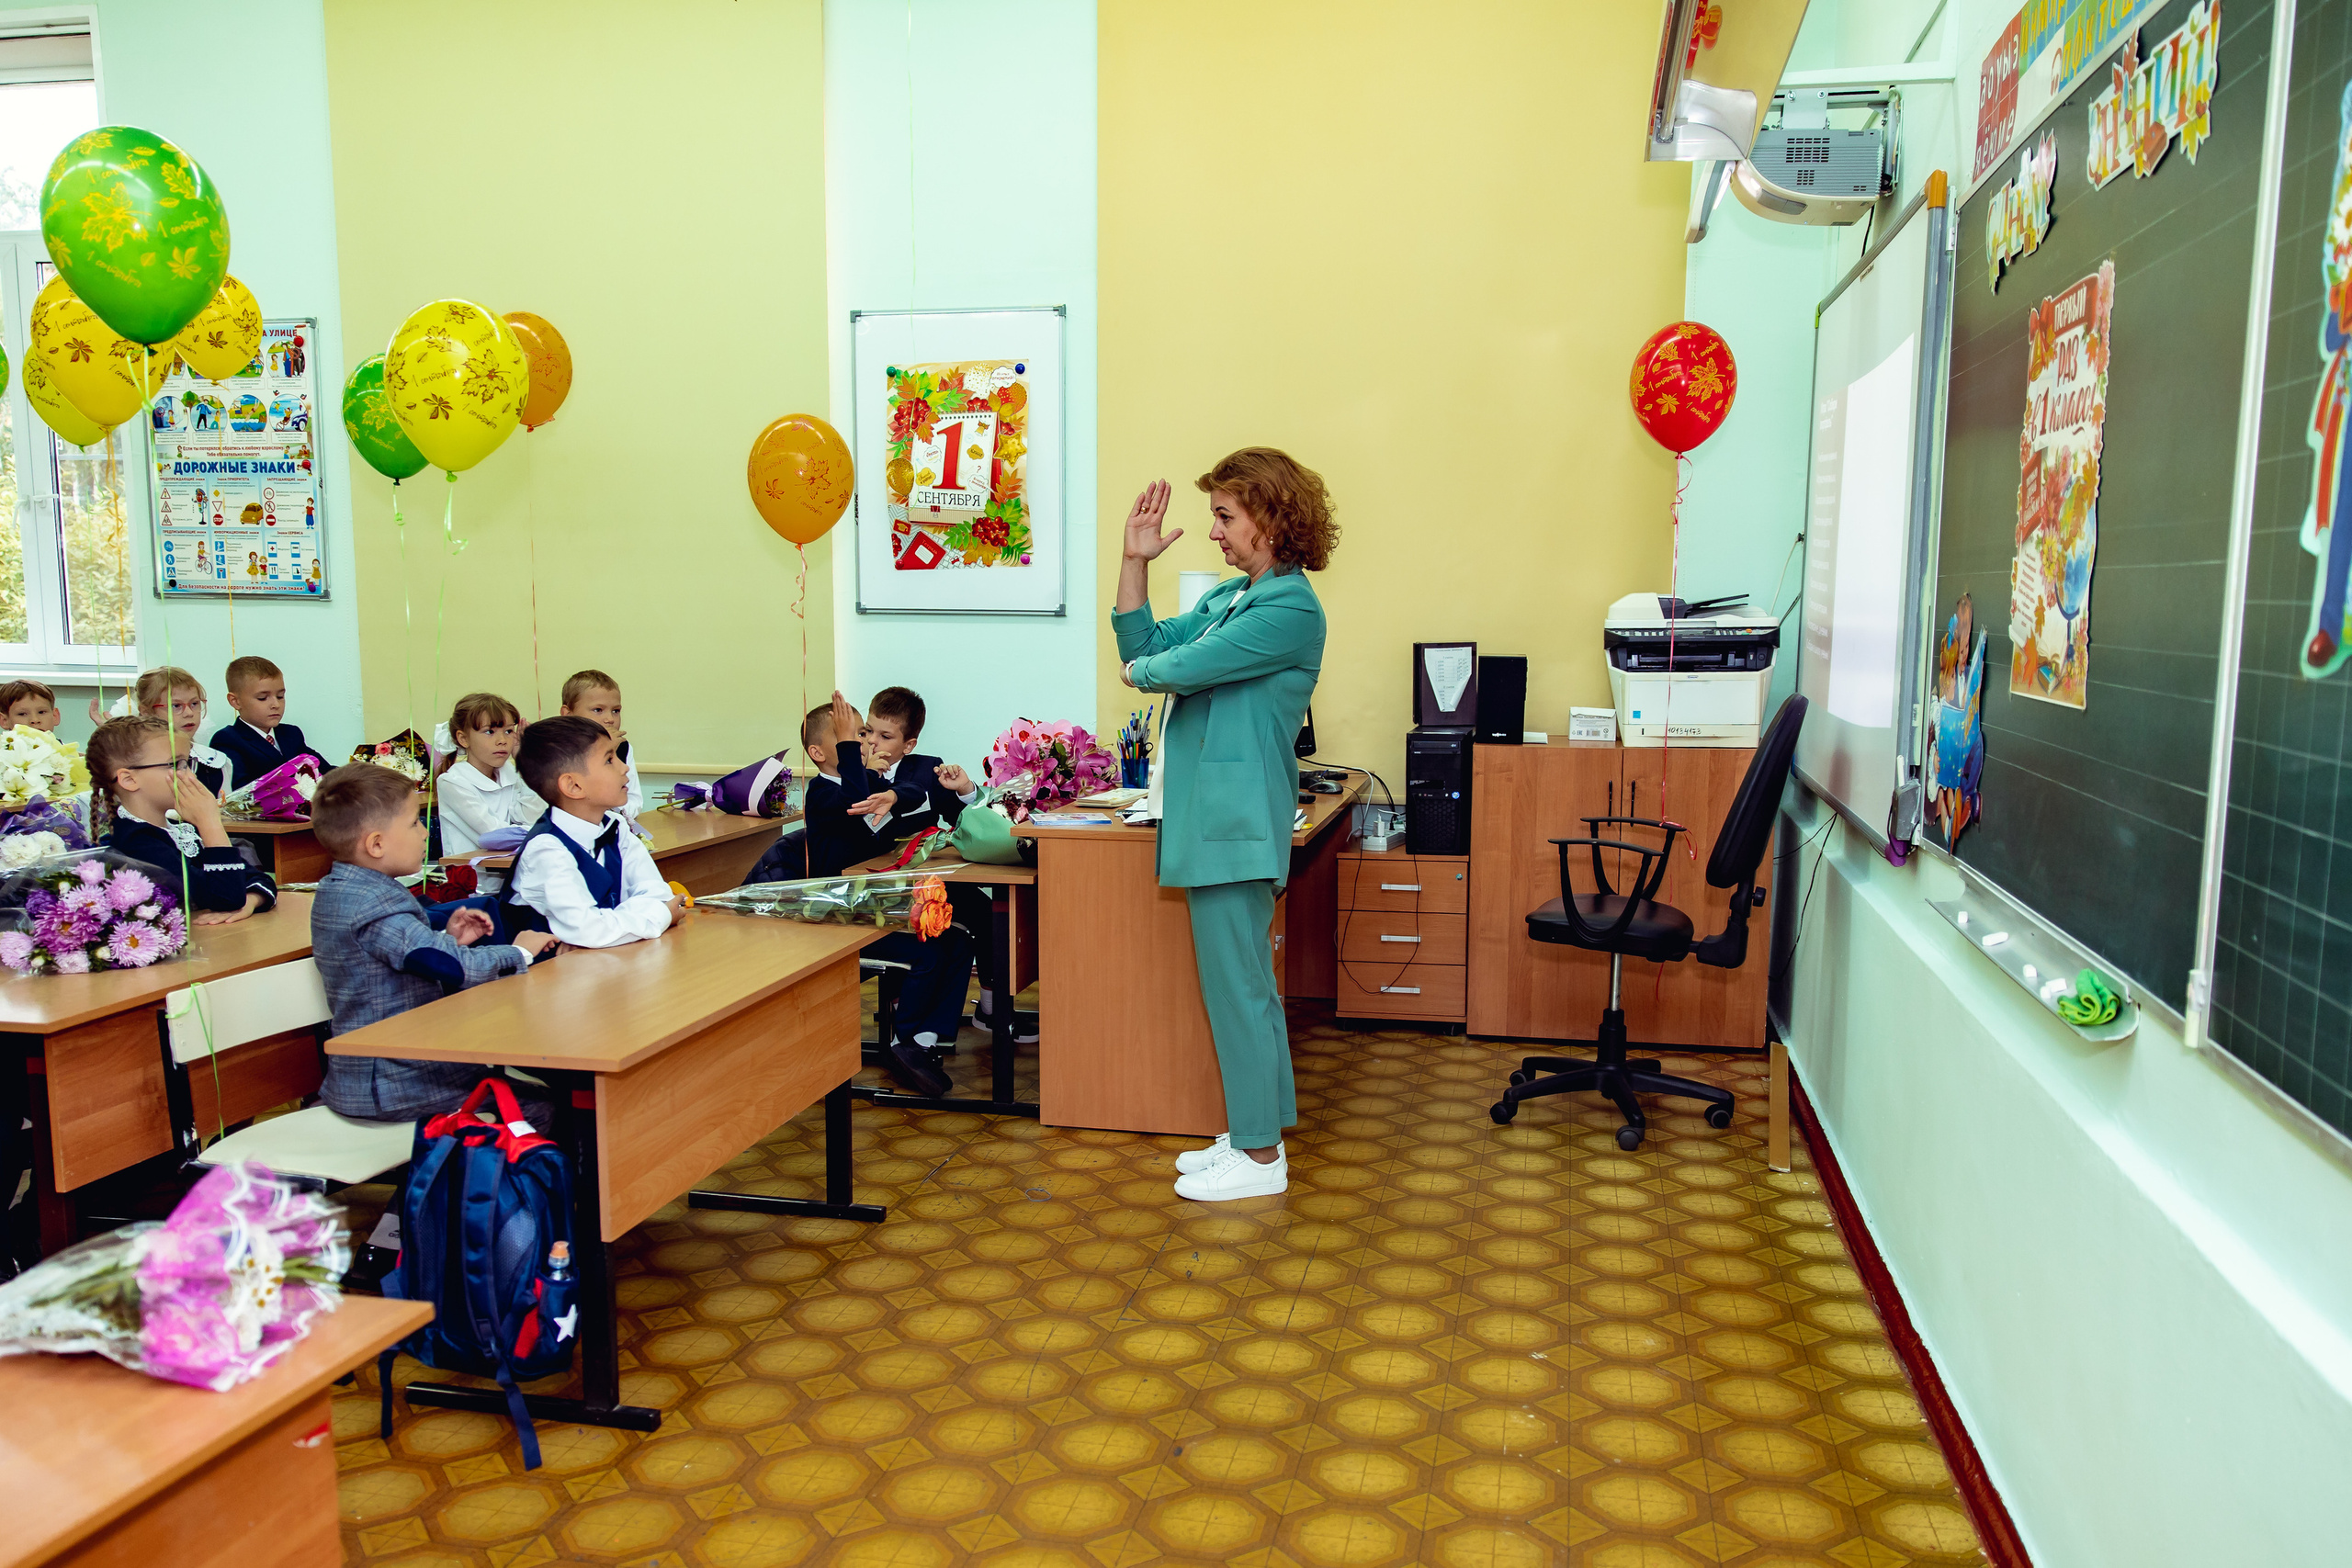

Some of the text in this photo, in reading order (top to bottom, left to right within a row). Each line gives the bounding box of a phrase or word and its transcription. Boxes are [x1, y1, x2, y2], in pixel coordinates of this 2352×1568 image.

[269, 329, 297, 337] УЛИЦЕ
[2058, 334, 2079, 387] РАЗ
[2040, 387, 2049, 436] 1
[174, 461, 295, 475] ДОРОЖНЫЕ ЗНАКИ
[933, 422, 967, 490] 1
[917, 491, 980, 507] СЕНТЯБРЯ
